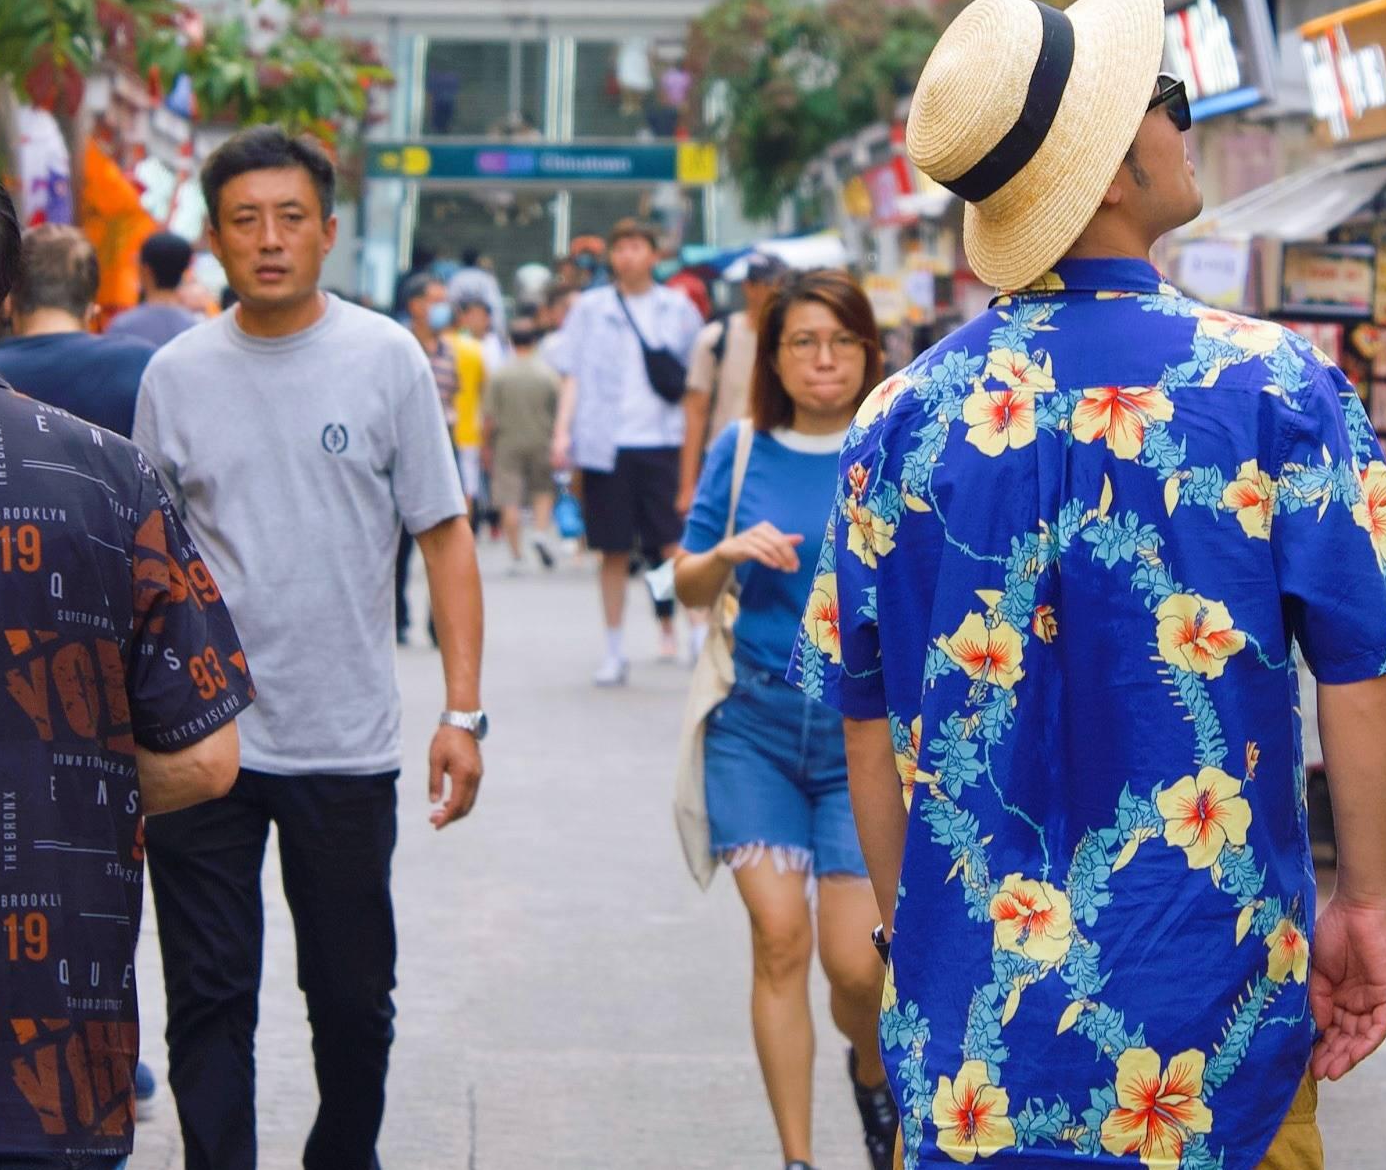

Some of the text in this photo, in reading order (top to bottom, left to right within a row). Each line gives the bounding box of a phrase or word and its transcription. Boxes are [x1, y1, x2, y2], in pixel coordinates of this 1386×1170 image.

[3, 792, 17, 870] THE BRONX
[3, 912, 50, 962] 19
